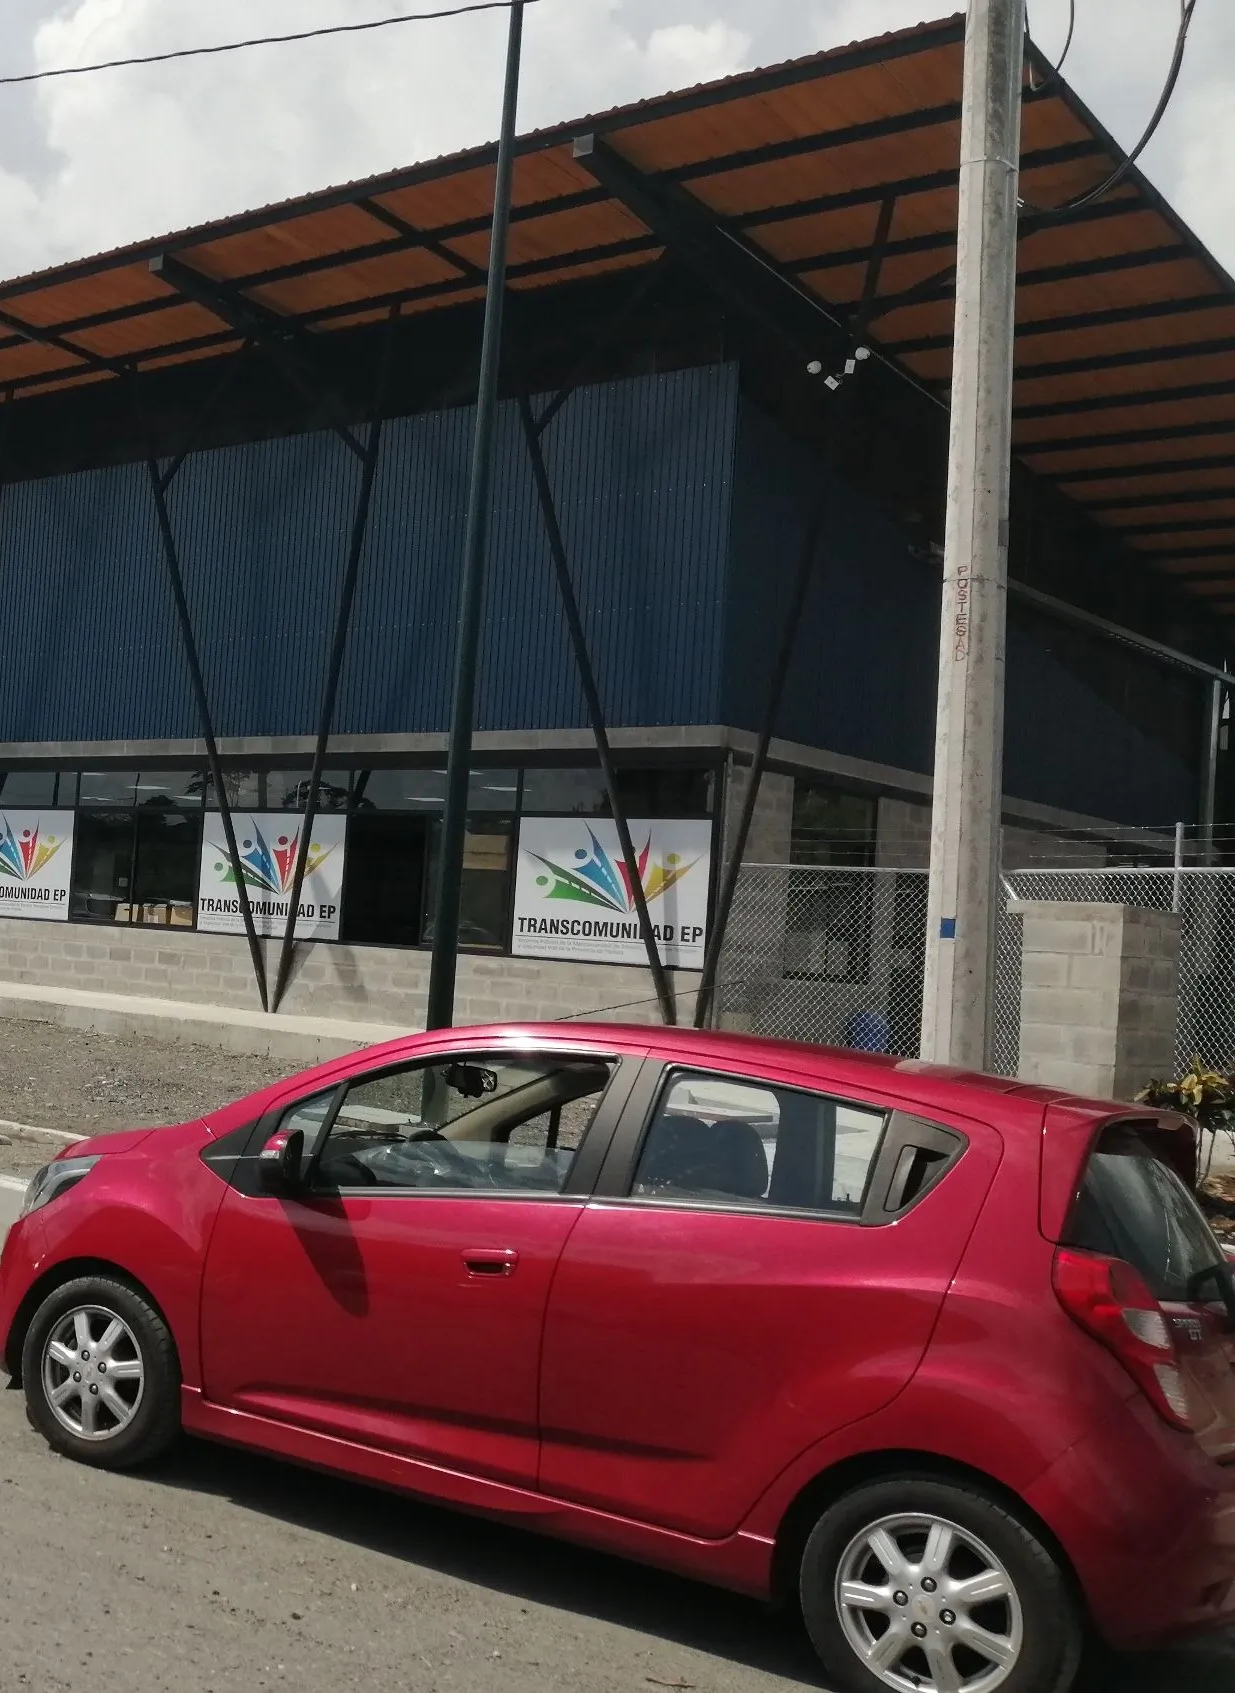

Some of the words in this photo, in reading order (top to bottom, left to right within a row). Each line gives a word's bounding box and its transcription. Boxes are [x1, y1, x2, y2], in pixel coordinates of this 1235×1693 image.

[53, 888, 67, 902] EP
[200, 898, 315, 918] TRANSOMUNIAD
[318, 904, 337, 919] EP
[680, 925, 704, 943] EP
